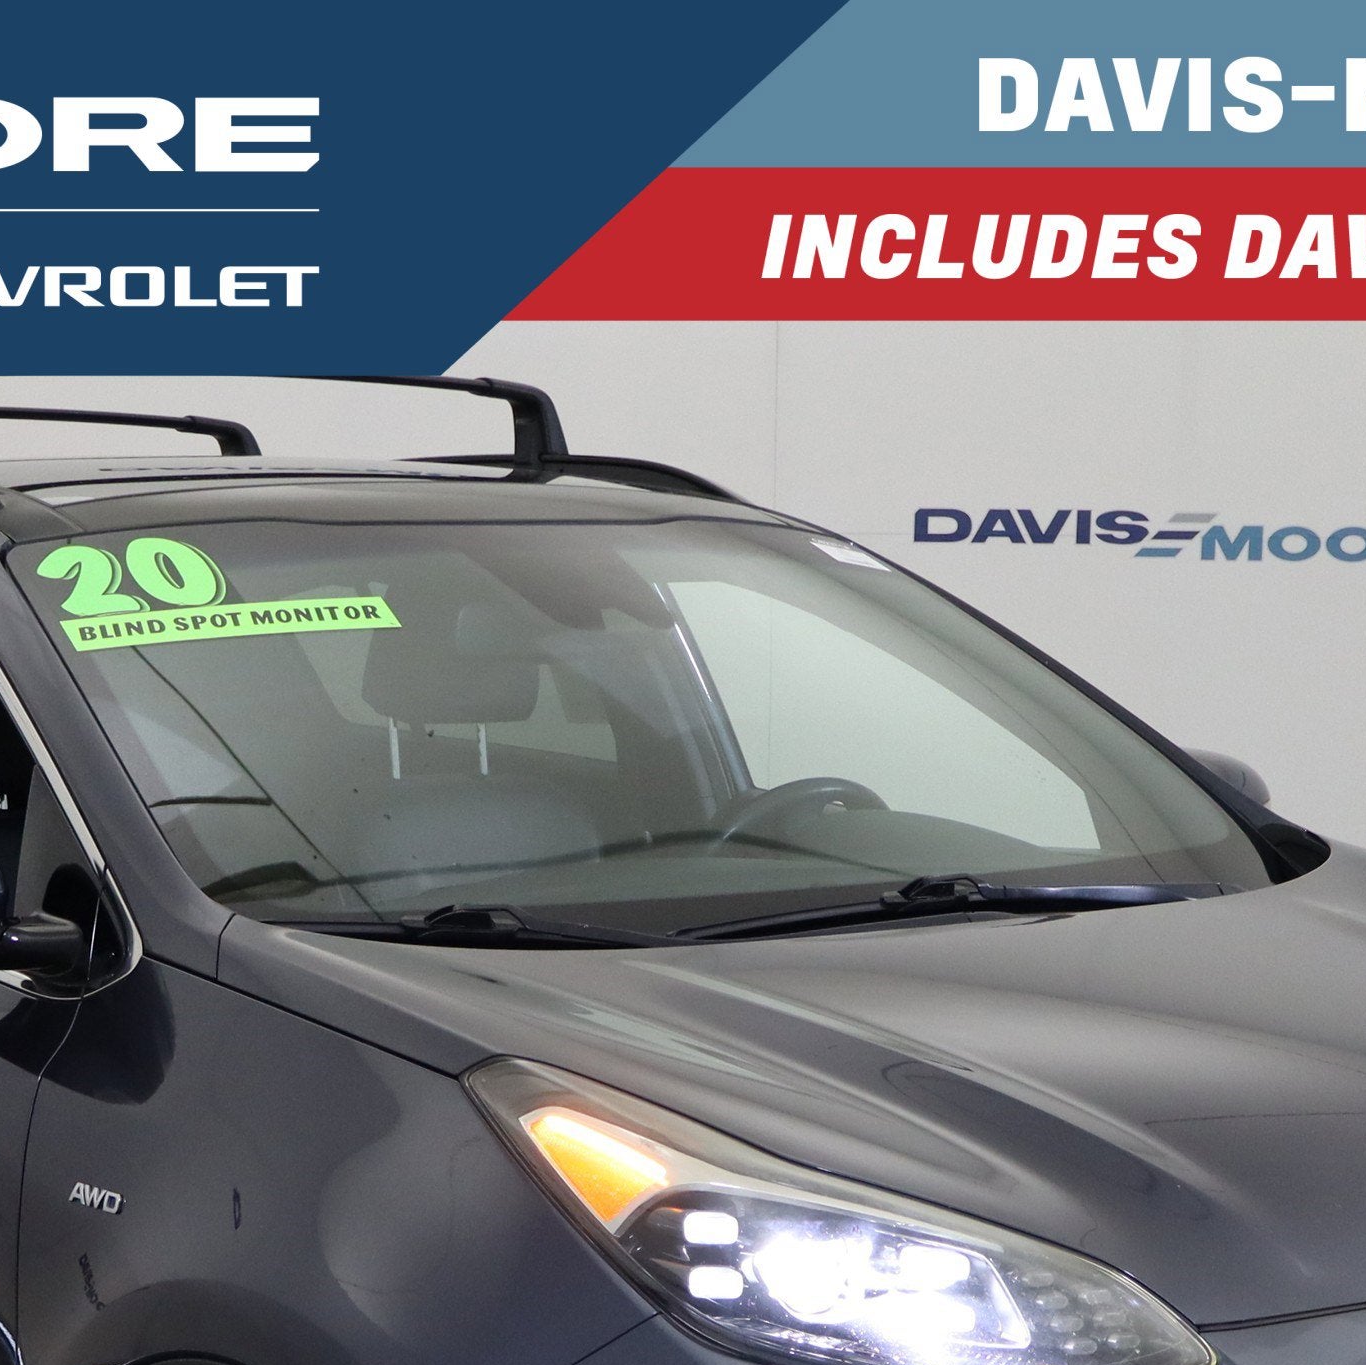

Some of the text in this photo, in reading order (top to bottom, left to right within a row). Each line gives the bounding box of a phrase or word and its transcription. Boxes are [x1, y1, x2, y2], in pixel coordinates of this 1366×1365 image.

[913, 507, 1150, 546] DAVIS
[37, 537, 226, 617] 20
[78, 604, 382, 642] BLIND SPOT MONITOR
[68, 1181, 124, 1215] AWD
